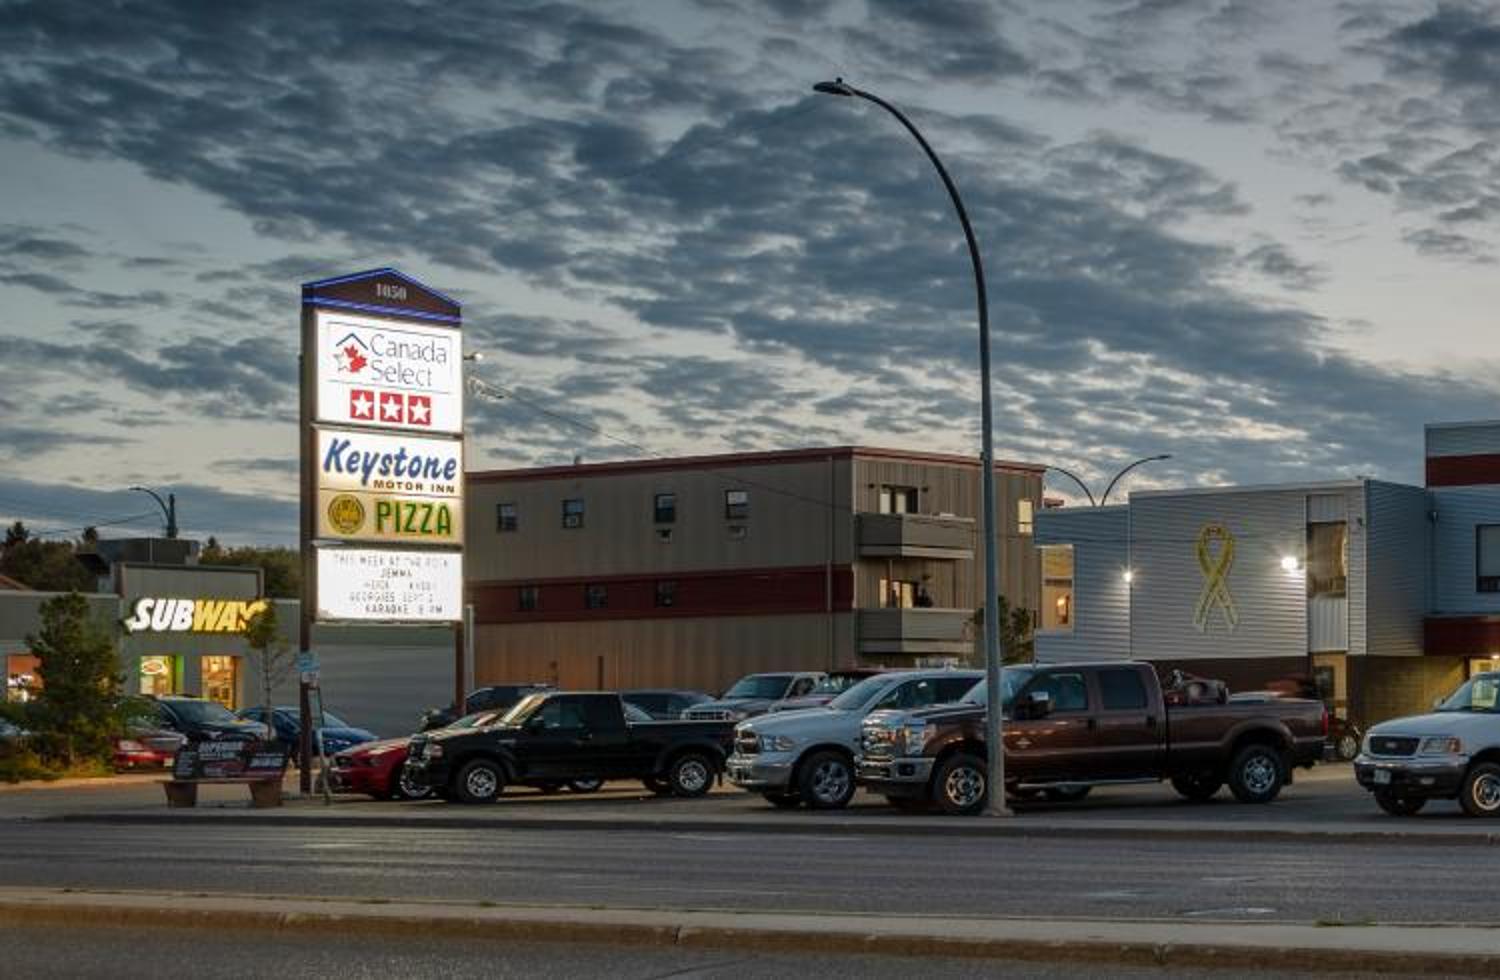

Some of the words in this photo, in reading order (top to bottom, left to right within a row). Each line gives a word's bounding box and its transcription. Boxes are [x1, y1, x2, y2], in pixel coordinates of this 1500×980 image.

[376, 284, 407, 300] 1050
[370, 333, 448, 365] Canada
[371, 360, 433, 387] Select
[323, 437, 457, 486] Keystone
[373, 479, 424, 491] MOTOR
[430, 482, 456, 494] INN
[376, 501, 453, 536] PIZZA
[126, 598, 267, 632] SUBWAY
[365, 603, 410, 616] KARAOKE
